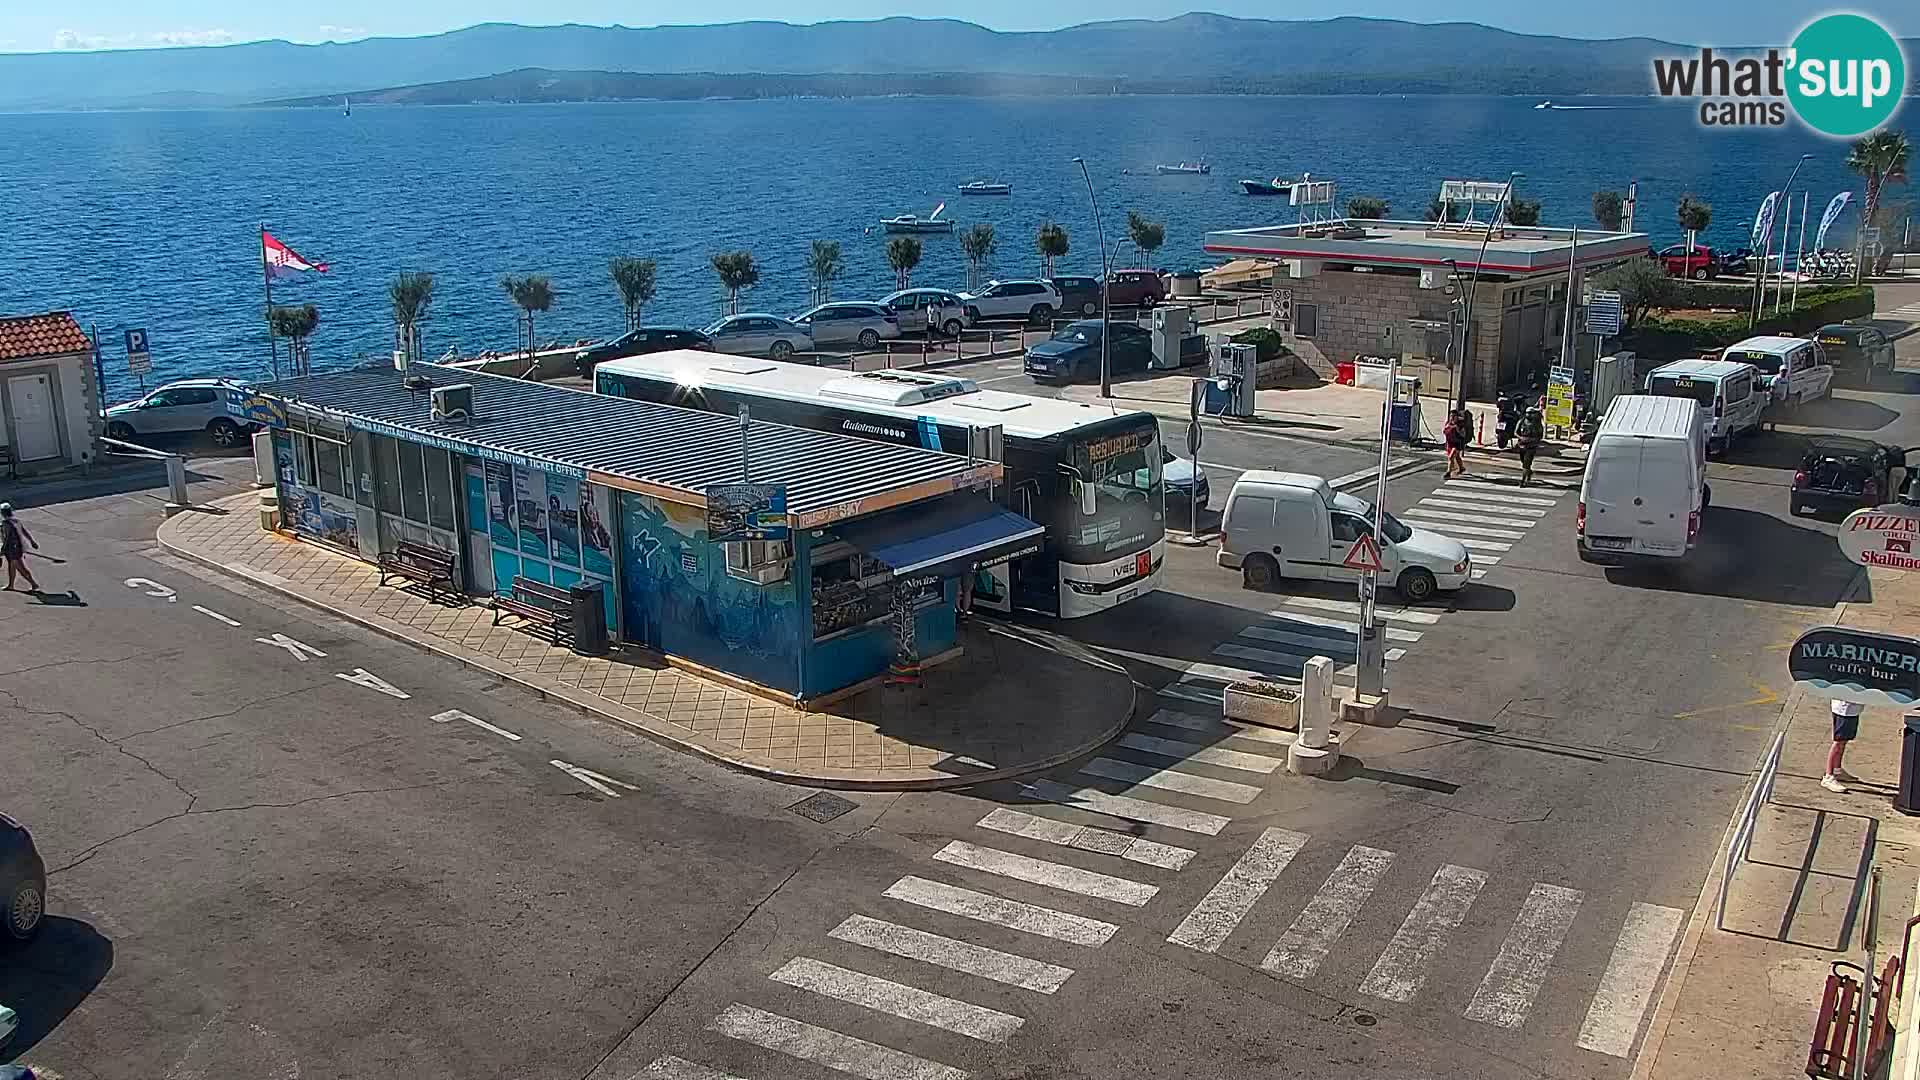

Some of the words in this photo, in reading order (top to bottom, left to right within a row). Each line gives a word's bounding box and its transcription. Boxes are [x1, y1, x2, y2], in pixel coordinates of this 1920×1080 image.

[130, 332, 143, 350] P
[1674, 380, 1693, 388] TAXI
[478, 447, 494, 458] BUS
[494, 450, 526, 466] STATION
[529, 458, 555, 473] TICKET
[556, 464, 584, 479] OFFICE
[1848, 516, 1920, 534] PIZZE
[1871, 666, 1898, 681] bar
